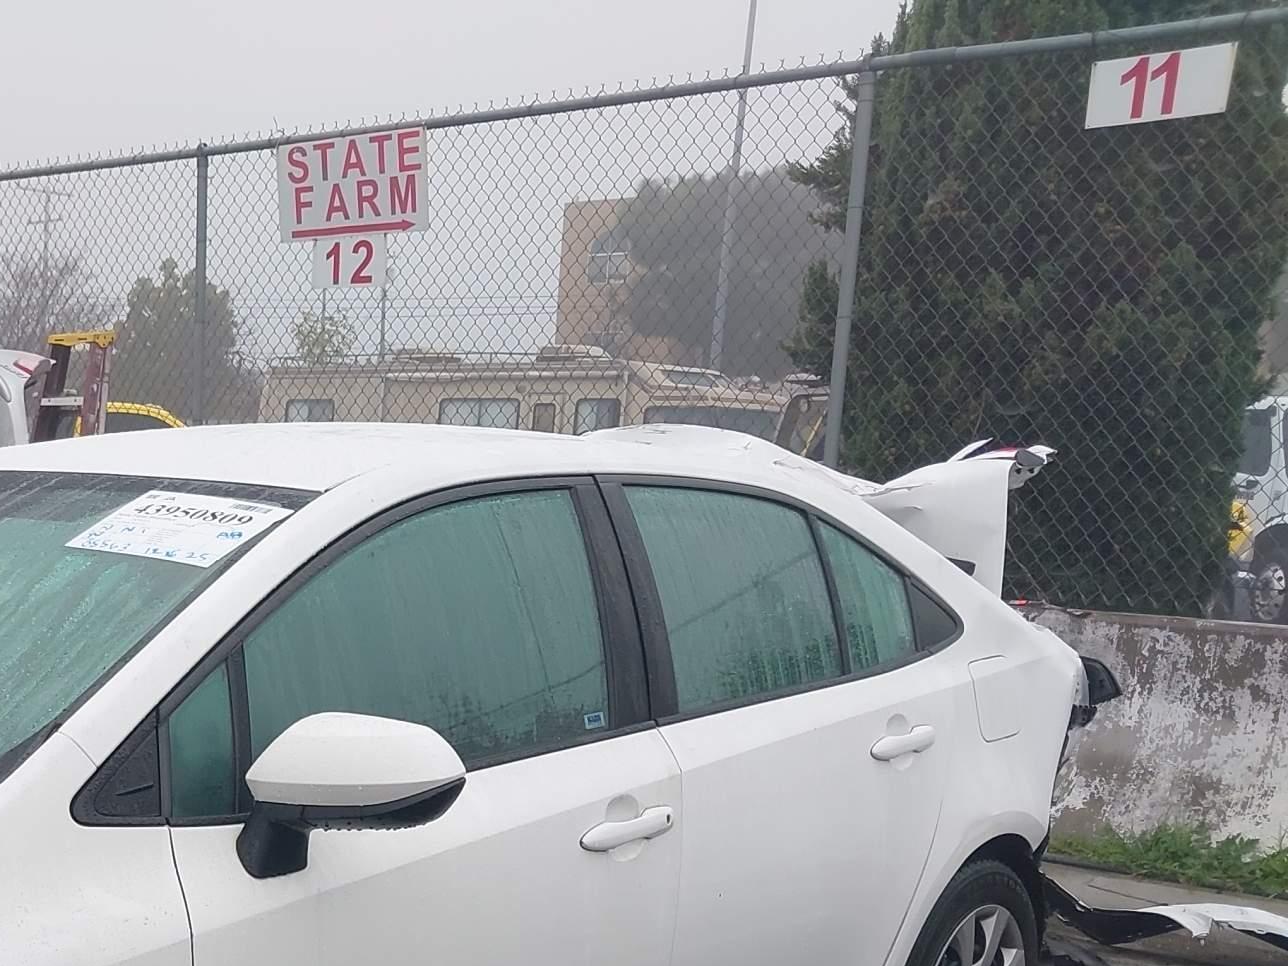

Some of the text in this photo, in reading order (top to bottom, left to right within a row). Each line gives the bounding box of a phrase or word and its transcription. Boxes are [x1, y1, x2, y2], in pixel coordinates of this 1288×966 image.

[1119, 51, 1182, 119] 11
[287, 130, 422, 184] STATE
[294, 174, 417, 224] FARM
[325, 239, 374, 285] 12
[134, 503, 254, 526] 43950809
